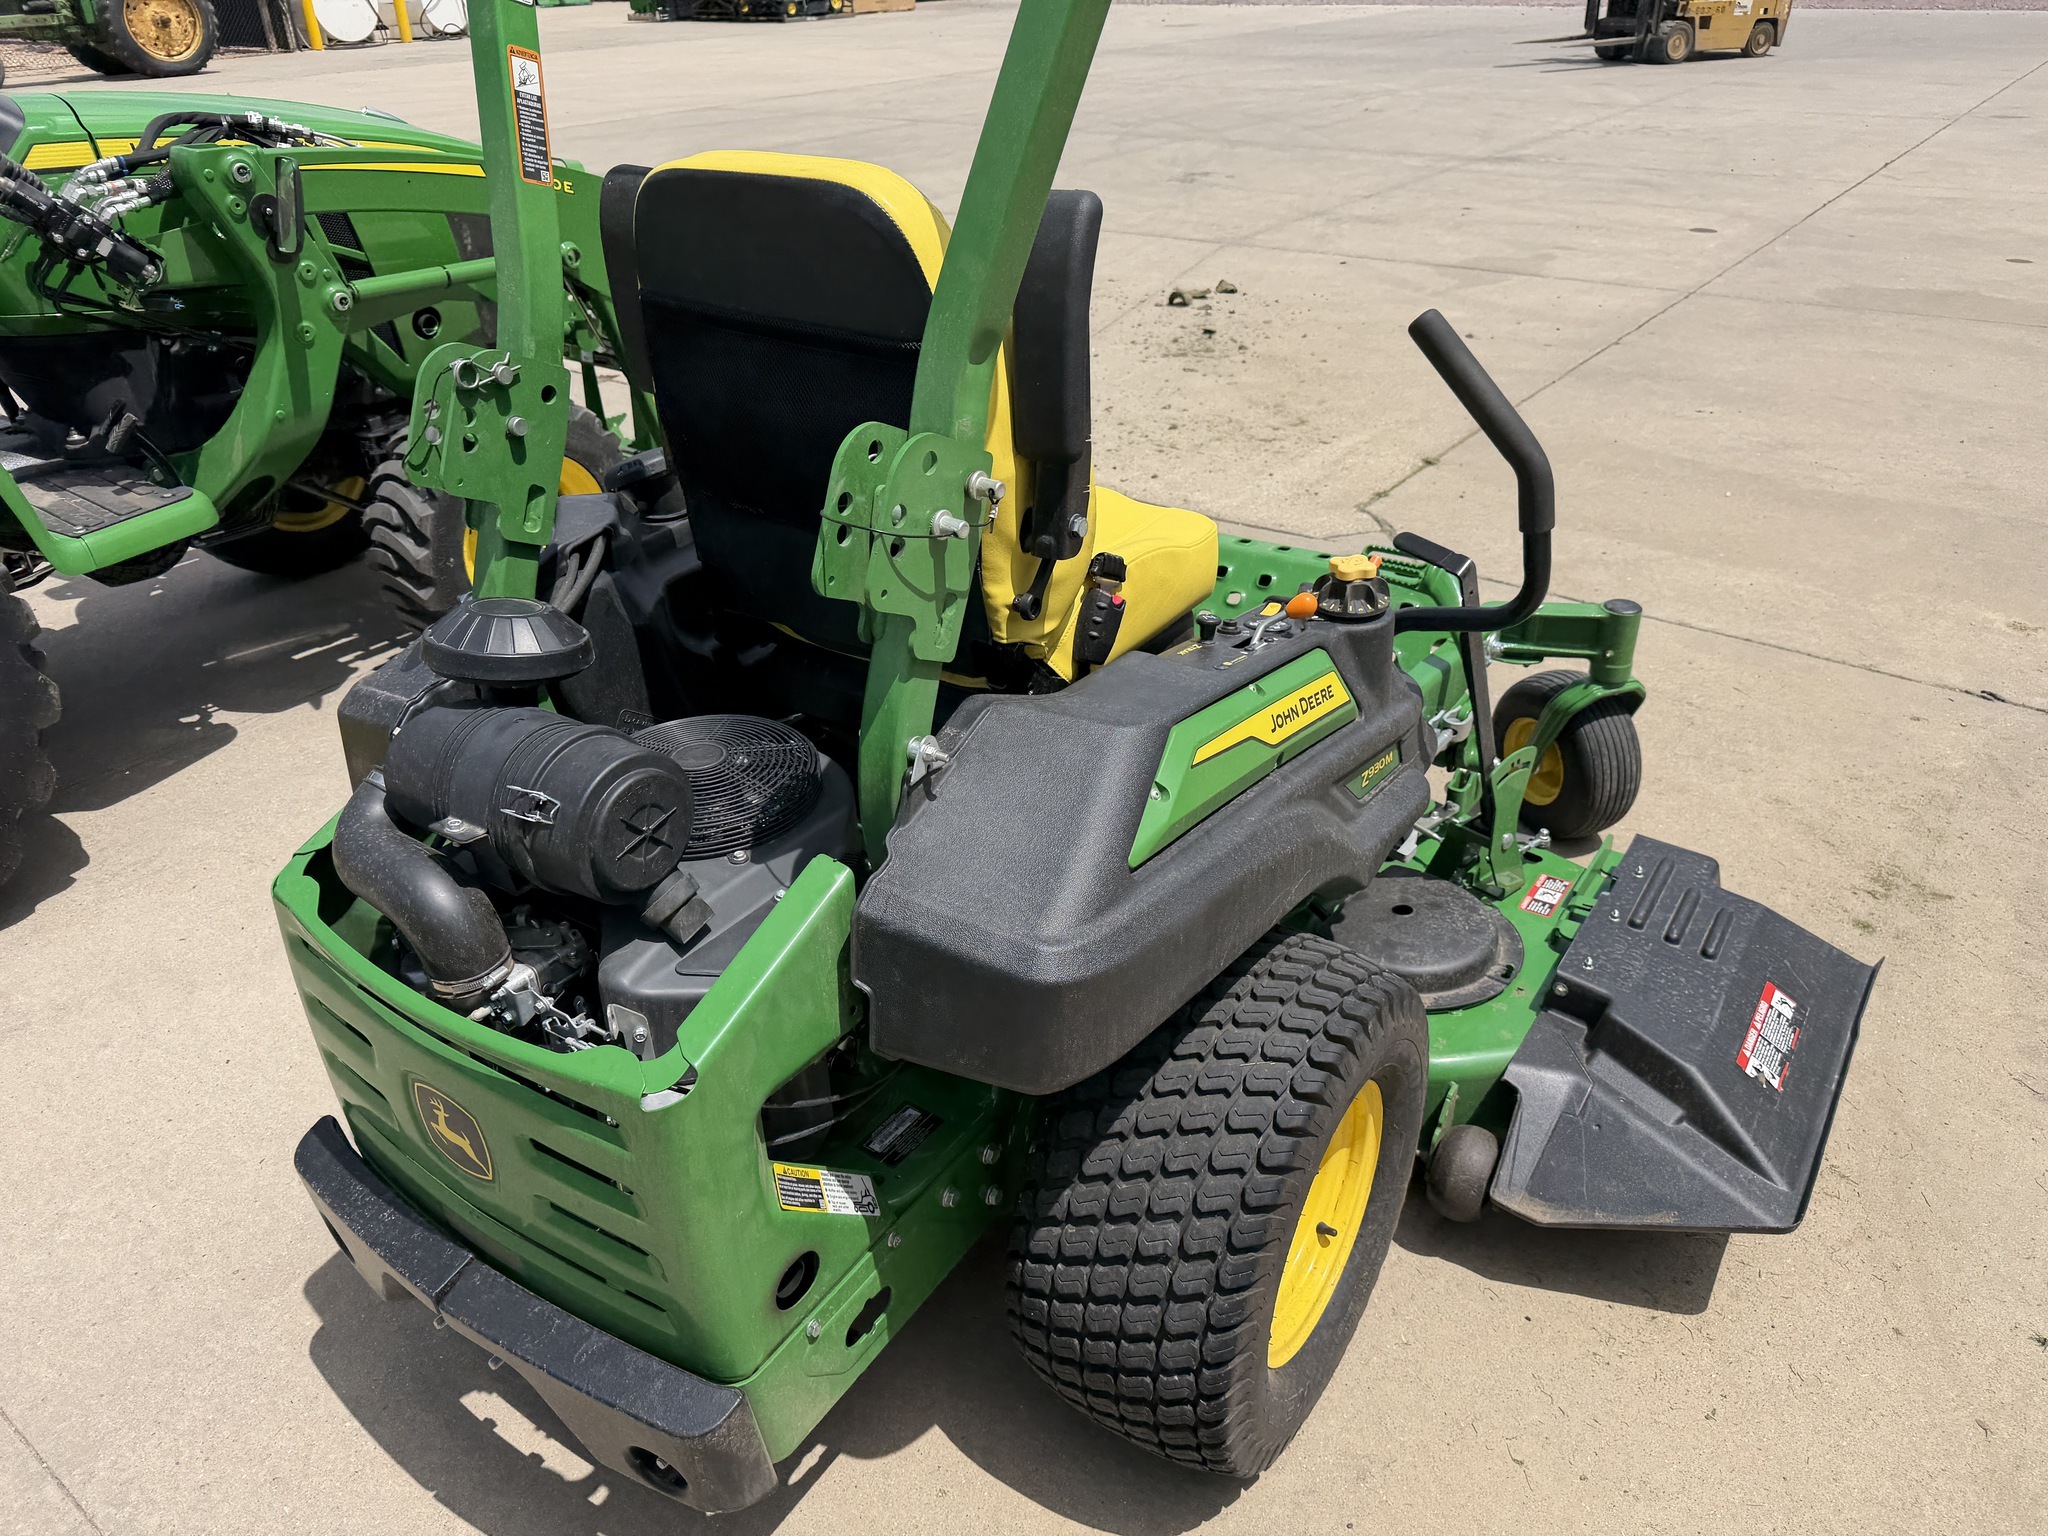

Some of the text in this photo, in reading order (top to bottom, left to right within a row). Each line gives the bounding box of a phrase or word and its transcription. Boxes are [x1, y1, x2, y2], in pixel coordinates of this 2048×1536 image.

[1271, 684, 1335, 734] JOHN DEERE
[1360, 750, 1394, 788] Z930M
[787, 1168, 810, 1178] CAUTION
